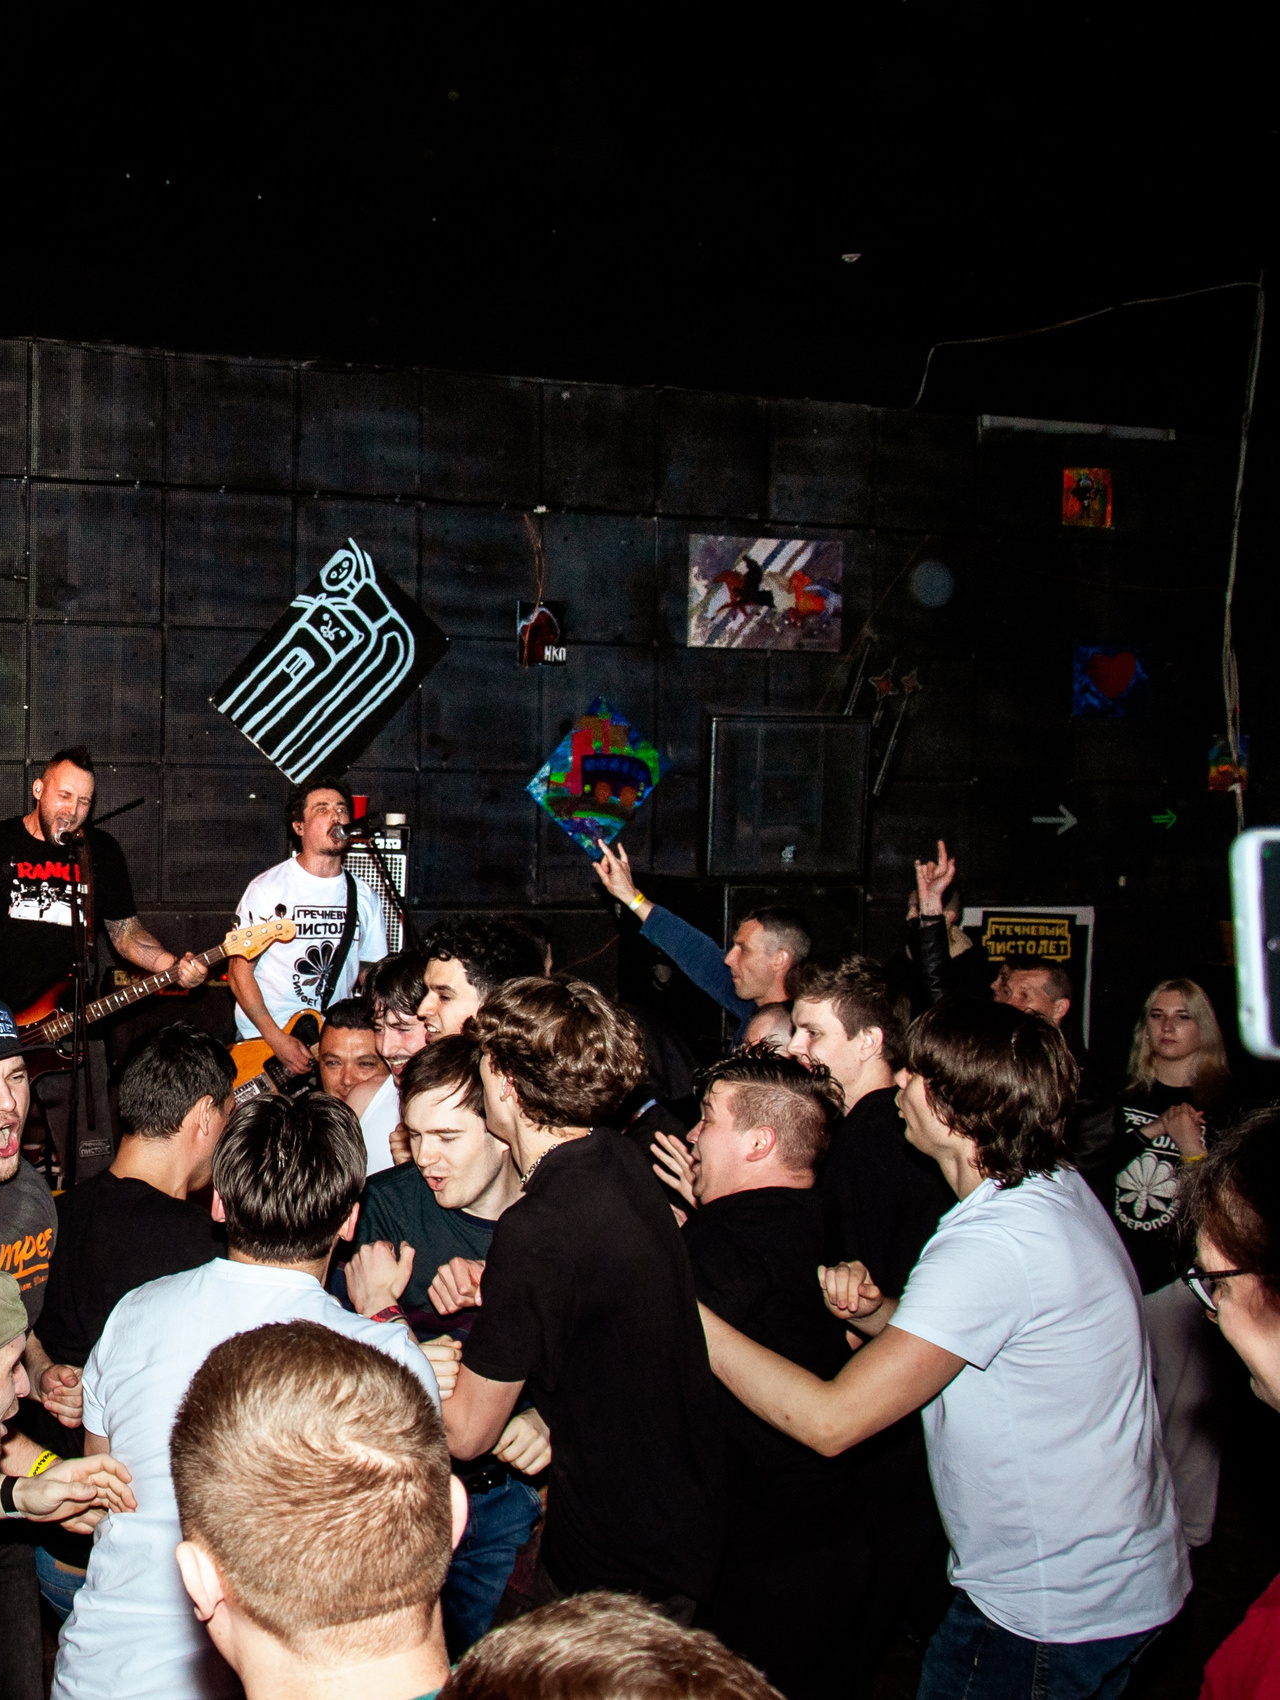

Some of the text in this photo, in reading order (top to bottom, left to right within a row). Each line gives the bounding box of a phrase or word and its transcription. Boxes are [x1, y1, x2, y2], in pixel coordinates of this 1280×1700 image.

[297, 909, 348, 920] ГРЕЧНЕВ
[295, 922, 346, 936] ПИСТОЛ
[990, 923, 1066, 937] ГРЕЧНЕВЫЙ
[985, 939, 1069, 955] ПИСТОЛЕТ
